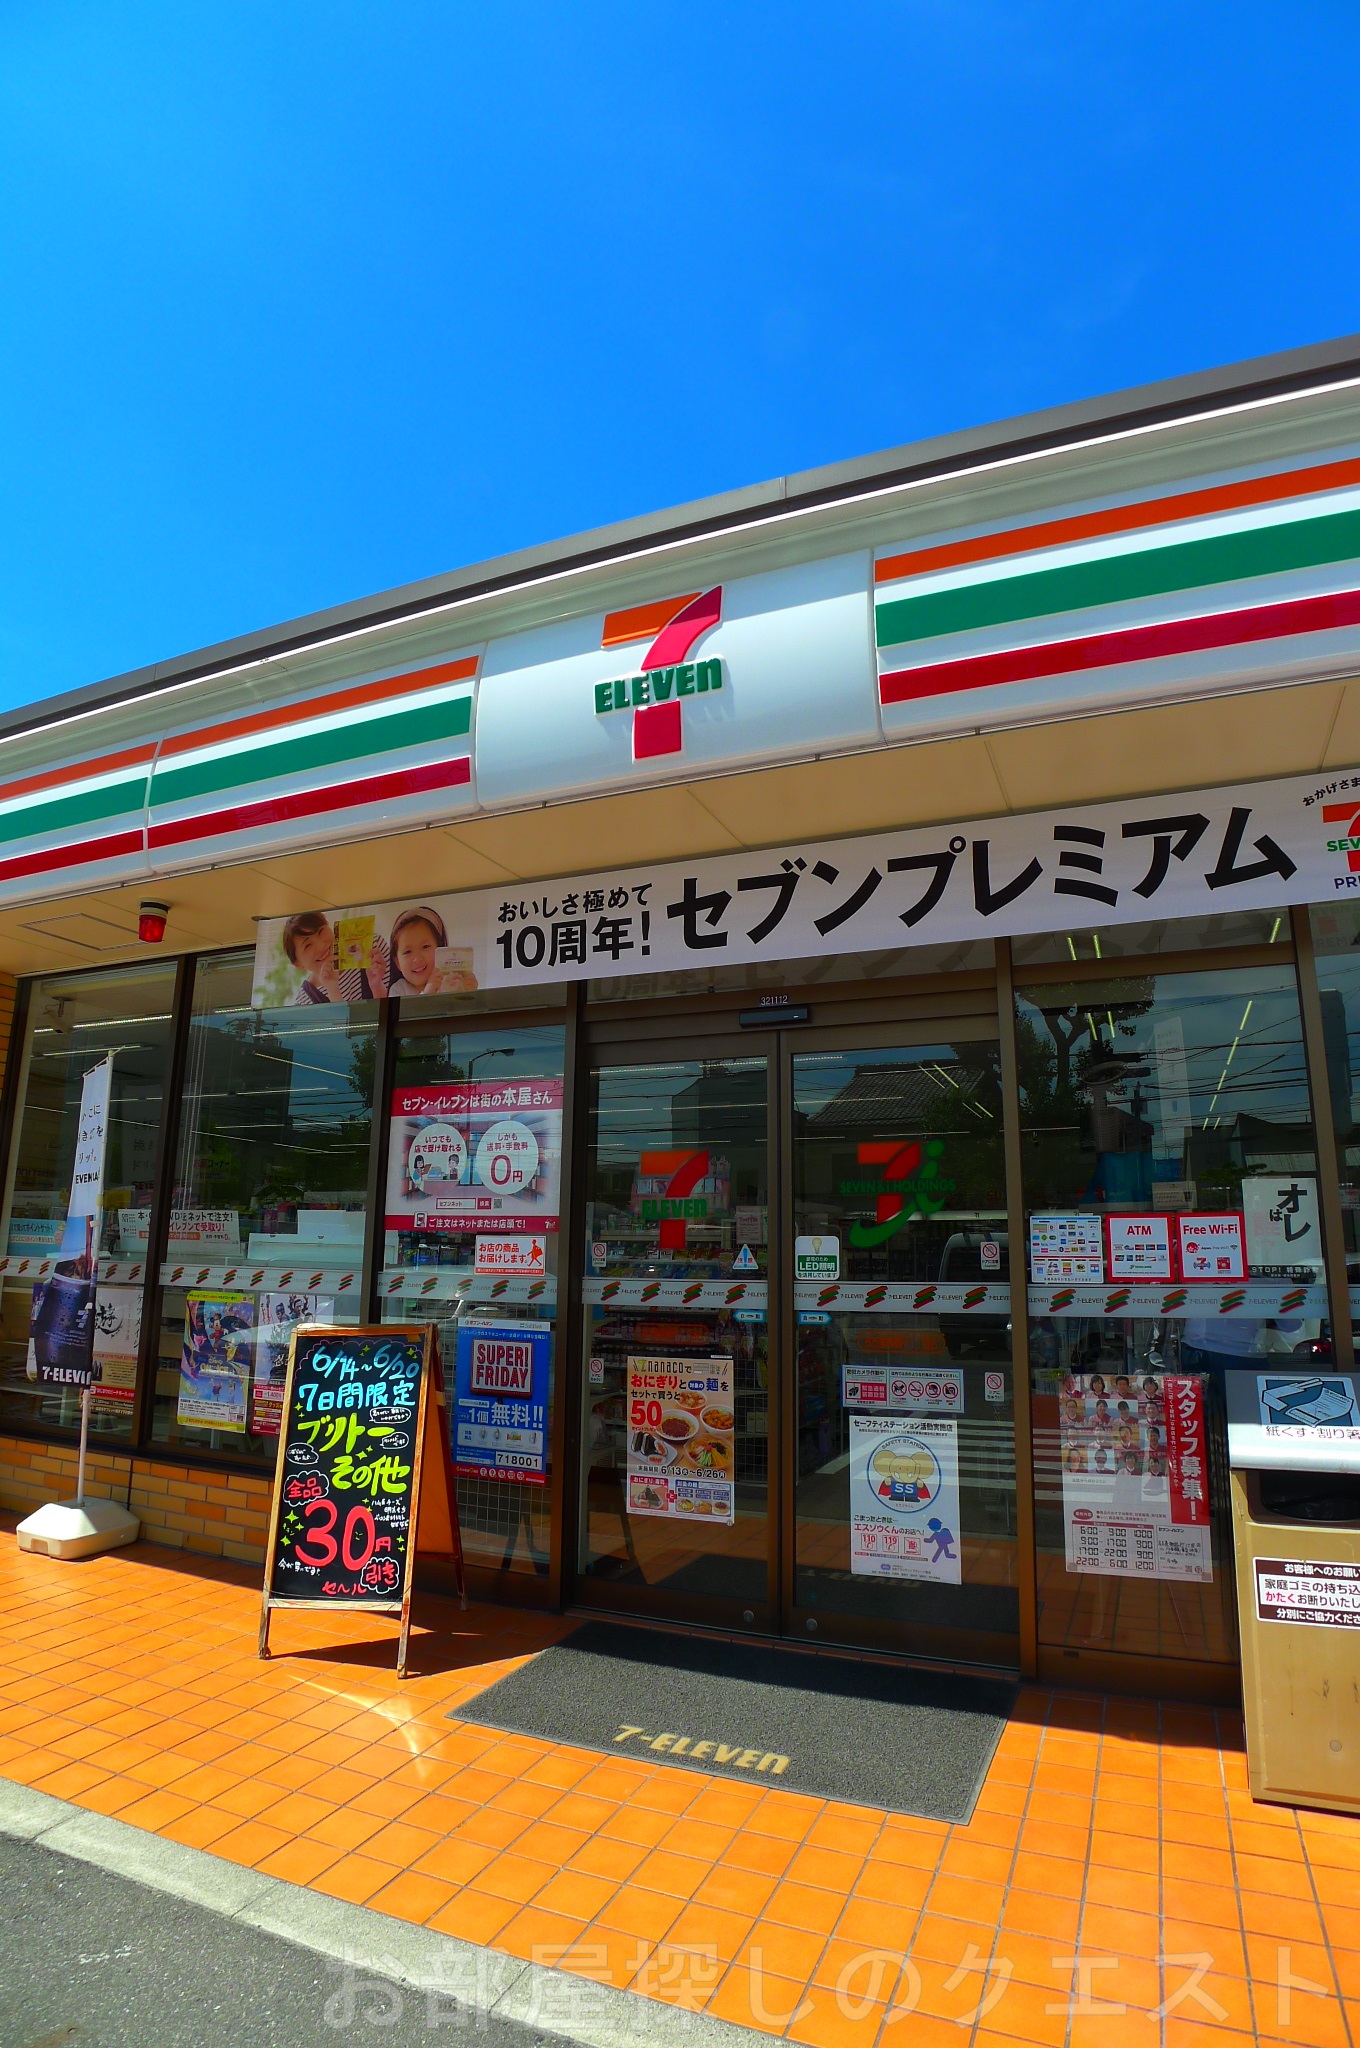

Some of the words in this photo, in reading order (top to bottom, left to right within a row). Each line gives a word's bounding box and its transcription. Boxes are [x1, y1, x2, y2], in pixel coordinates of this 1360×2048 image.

[667, 807, 1297, 950] セブンプレミアム
[497, 883, 652, 922] おいしさ極めて
[496, 910, 651, 968] 10周年!
[760, 995, 788, 1006] 321112
[425, 1135, 452, 1143] いつでも
[490, 1154, 523, 1186] 0円
[1127, 1225, 1152, 1236] ATM
[1183, 1224, 1206, 1235] Free
[1208, 1223, 1238, 1235] Wi-Fi
[479, 1243, 519, 1253] お店の商品
[799, 1261, 836, 1271] LED照明
[477, 1343, 529, 1367] SUPER!
[476, 1364, 529, 1388] FRIDAY
[299, 1380, 415, 1411] 7日間限定
[631, 1389, 680, 1400] セットで買うと
[631, 1400, 662, 1427] 50
[297, 1412, 395, 1454] ブリトー
[497, 1454, 538, 1468] 718001
[330, 1455, 410, 1496] その他
[286, 1477, 323, 1498] 全品
[894, 1484, 914, 1494] SS
[863, 1534, 876, 1543] 110
[884, 1536, 897, 1545] 119
[365, 1560, 396, 1585] 引き
[1264, 1578, 1360, 1595] 家庭ゴミの持ち込
